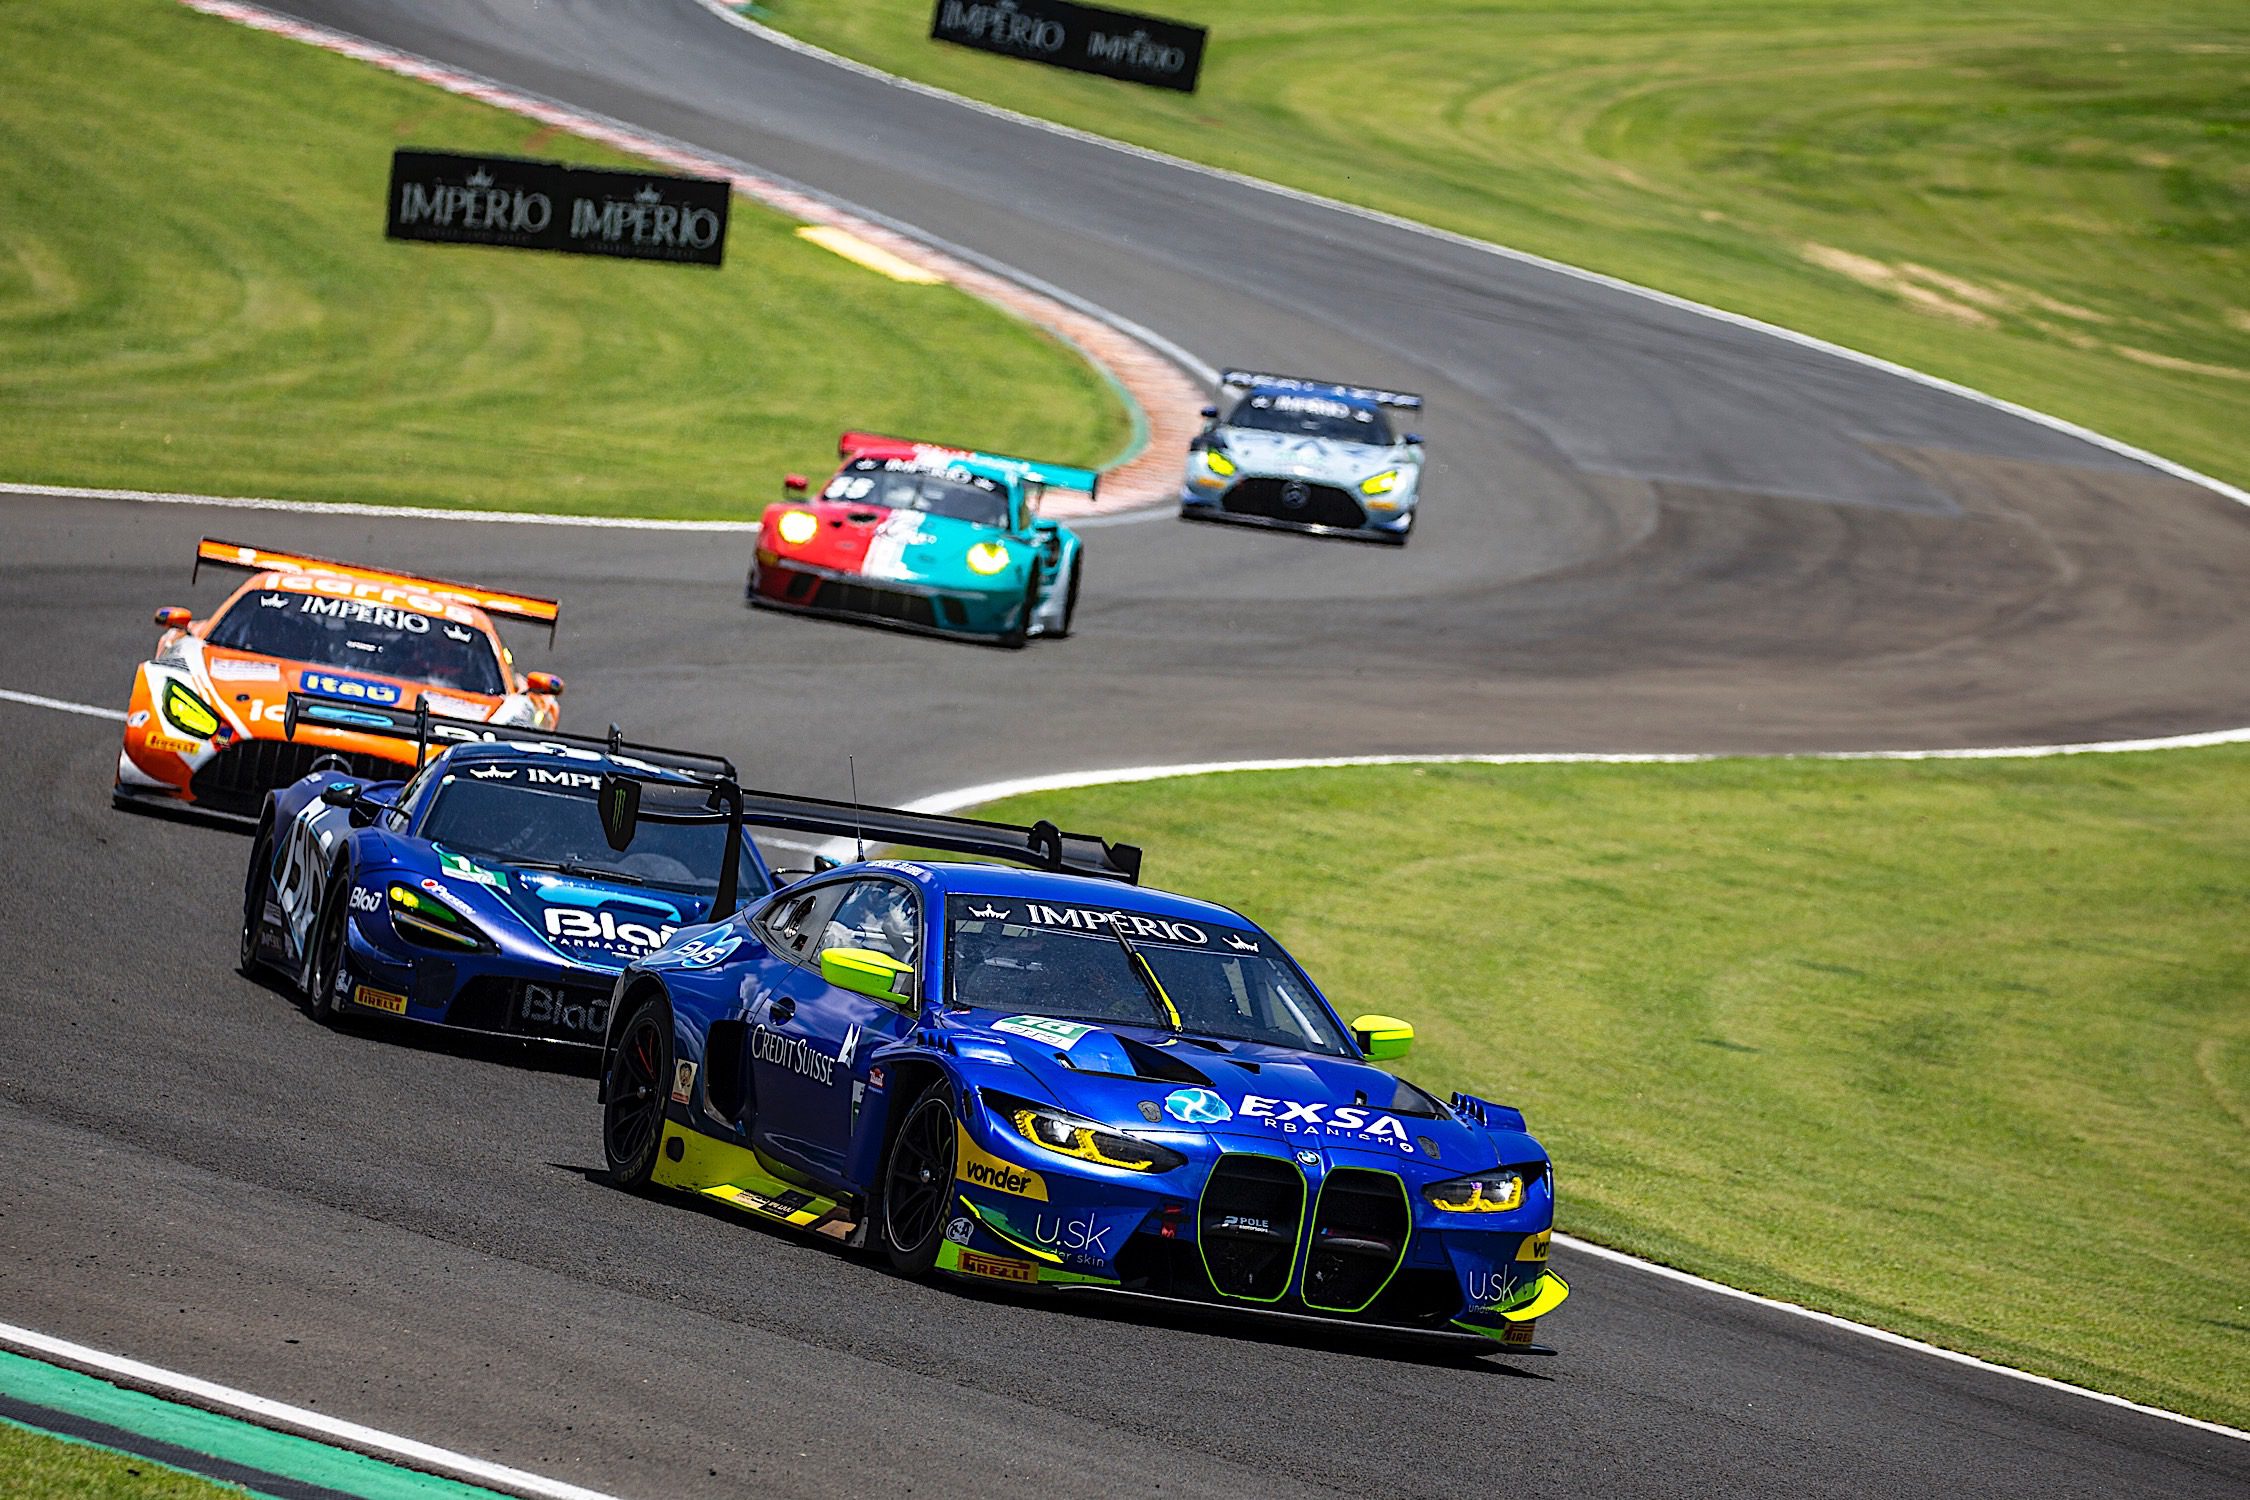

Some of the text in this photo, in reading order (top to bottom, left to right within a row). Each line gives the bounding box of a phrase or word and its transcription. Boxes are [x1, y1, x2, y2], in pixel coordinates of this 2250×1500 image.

[673, 940, 726, 964] EMS
[752, 1023, 835, 1087] CREDIT SUISSE
[1239, 1094, 1409, 1142] EXSA
[967, 1160, 1031, 1194] vonder
[1239, 1217, 1269, 1228] POLE
[1076, 1253, 1105, 1268] skin
